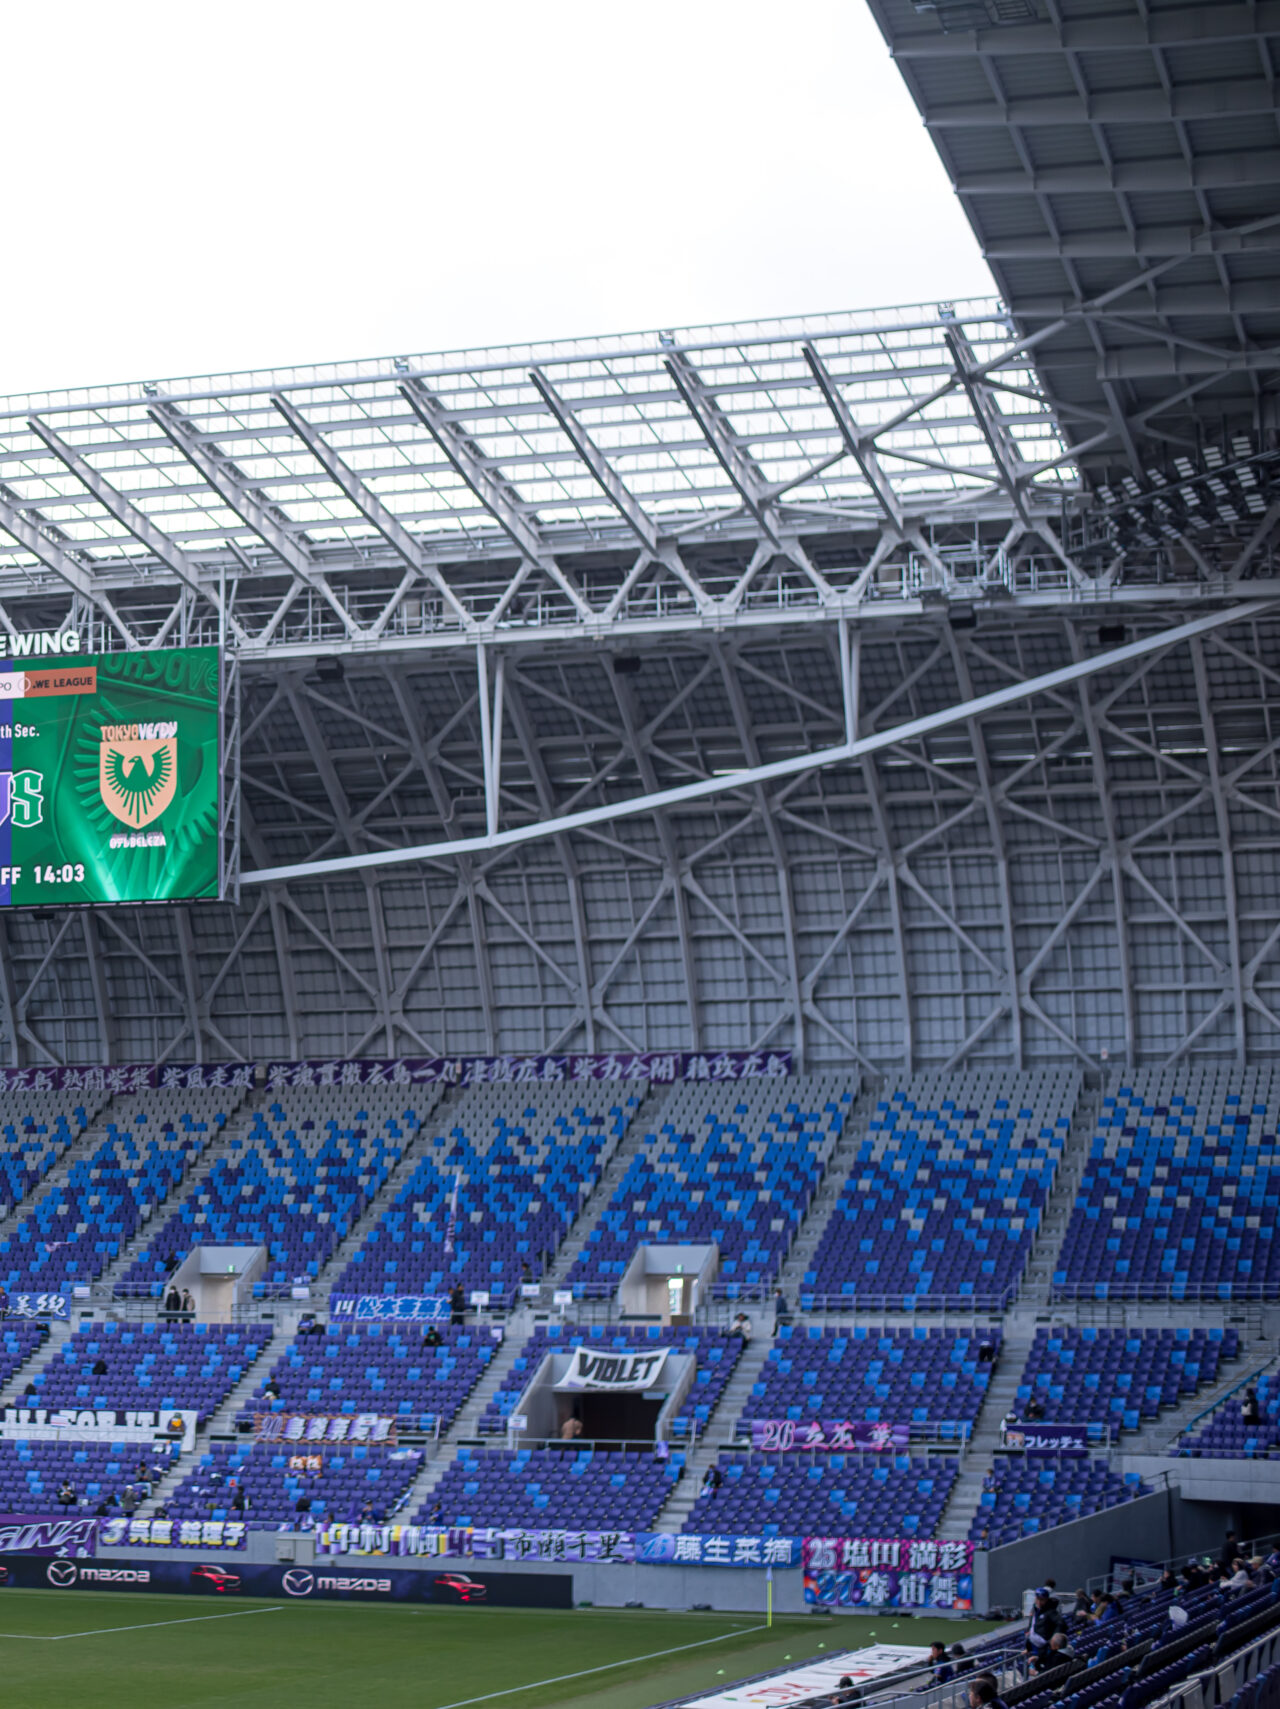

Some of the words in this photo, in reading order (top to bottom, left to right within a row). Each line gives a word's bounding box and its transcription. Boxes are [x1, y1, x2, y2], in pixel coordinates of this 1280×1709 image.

[9, 630, 80, 656] WING
[54, 676, 93, 688] LEAGUE
[14, 724, 40, 738] Sec.
[34, 864, 85, 884] 14:03
[335, 1300, 354, 1316] 14
[577, 1354, 661, 1383] VIOLET
[807, 1538, 838, 1569] 25
[842, 1538, 900, 1568] 塩田
